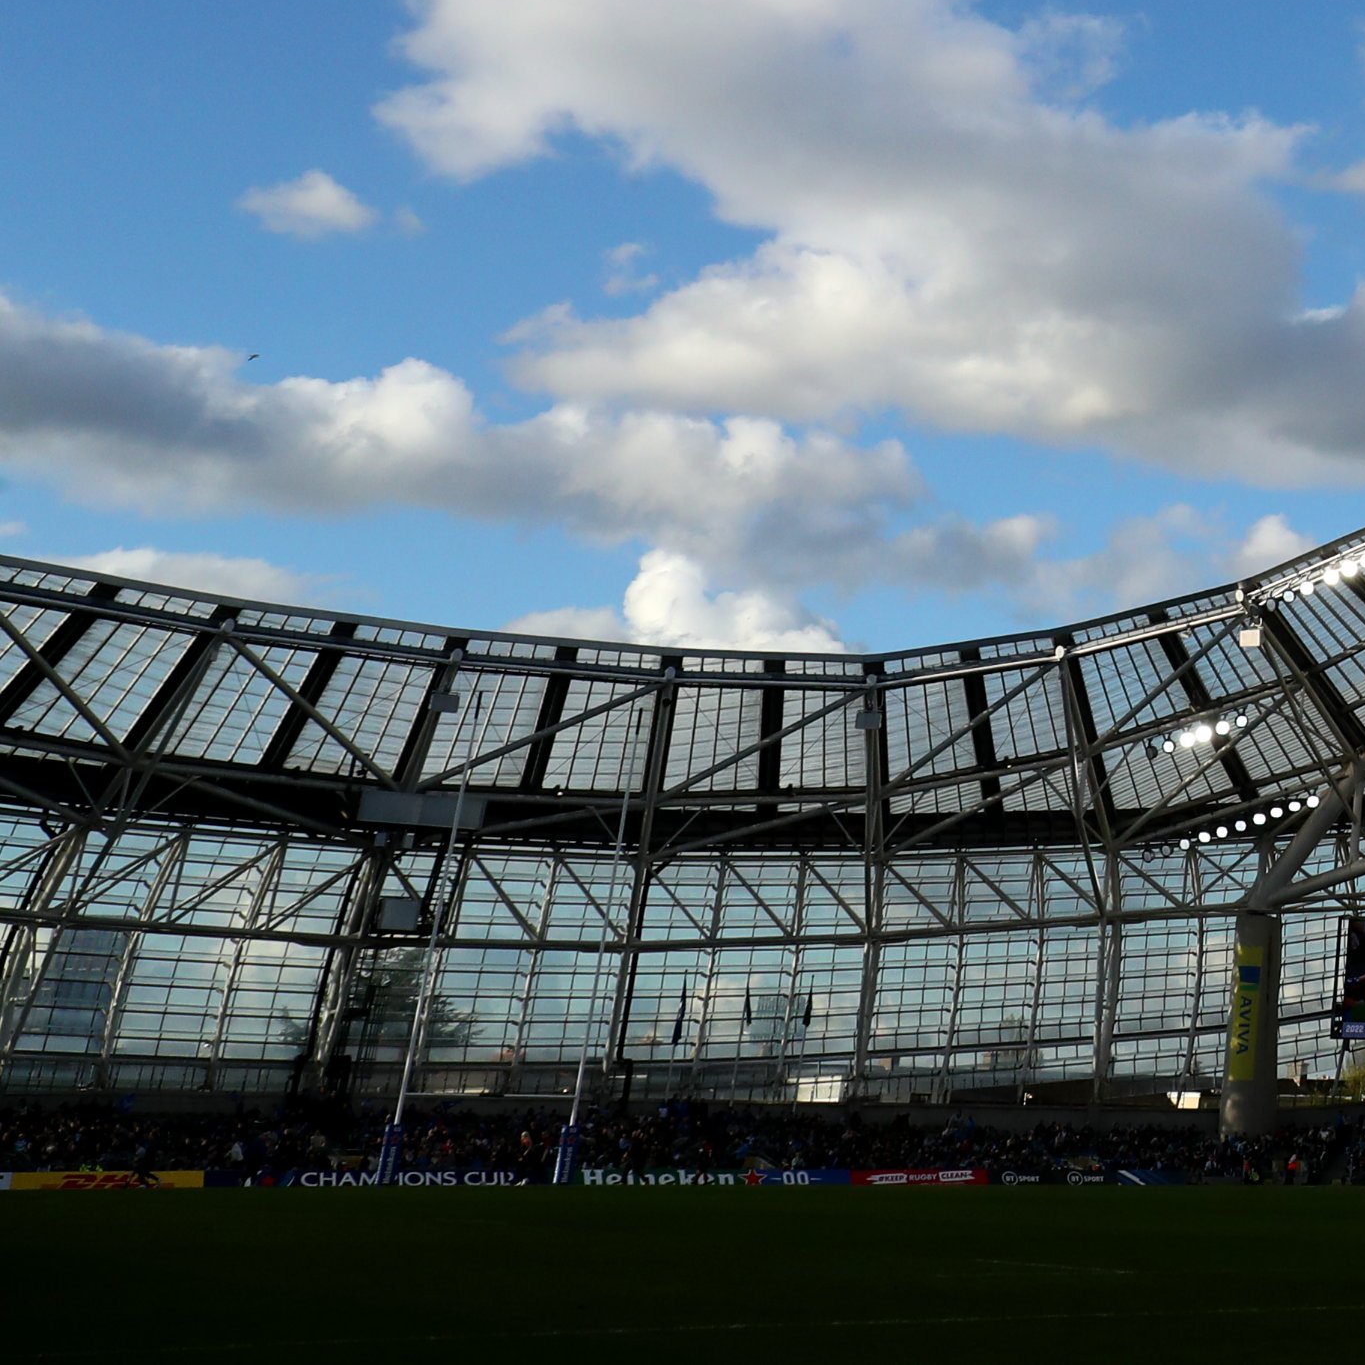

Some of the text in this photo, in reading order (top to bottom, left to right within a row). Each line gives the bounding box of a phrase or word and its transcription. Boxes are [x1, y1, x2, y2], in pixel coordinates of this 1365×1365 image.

[1236, 996, 1253, 1055] AVIVA
[1345, 1024, 1364, 1033] 2022
[300, 1171, 514, 1186] CHAMIONS CUP
[941, 1172, 968, 1180] CLEAN
[1018, 1175, 1040, 1183] SPORT
[1083, 1175, 1105, 1183] SPORT
